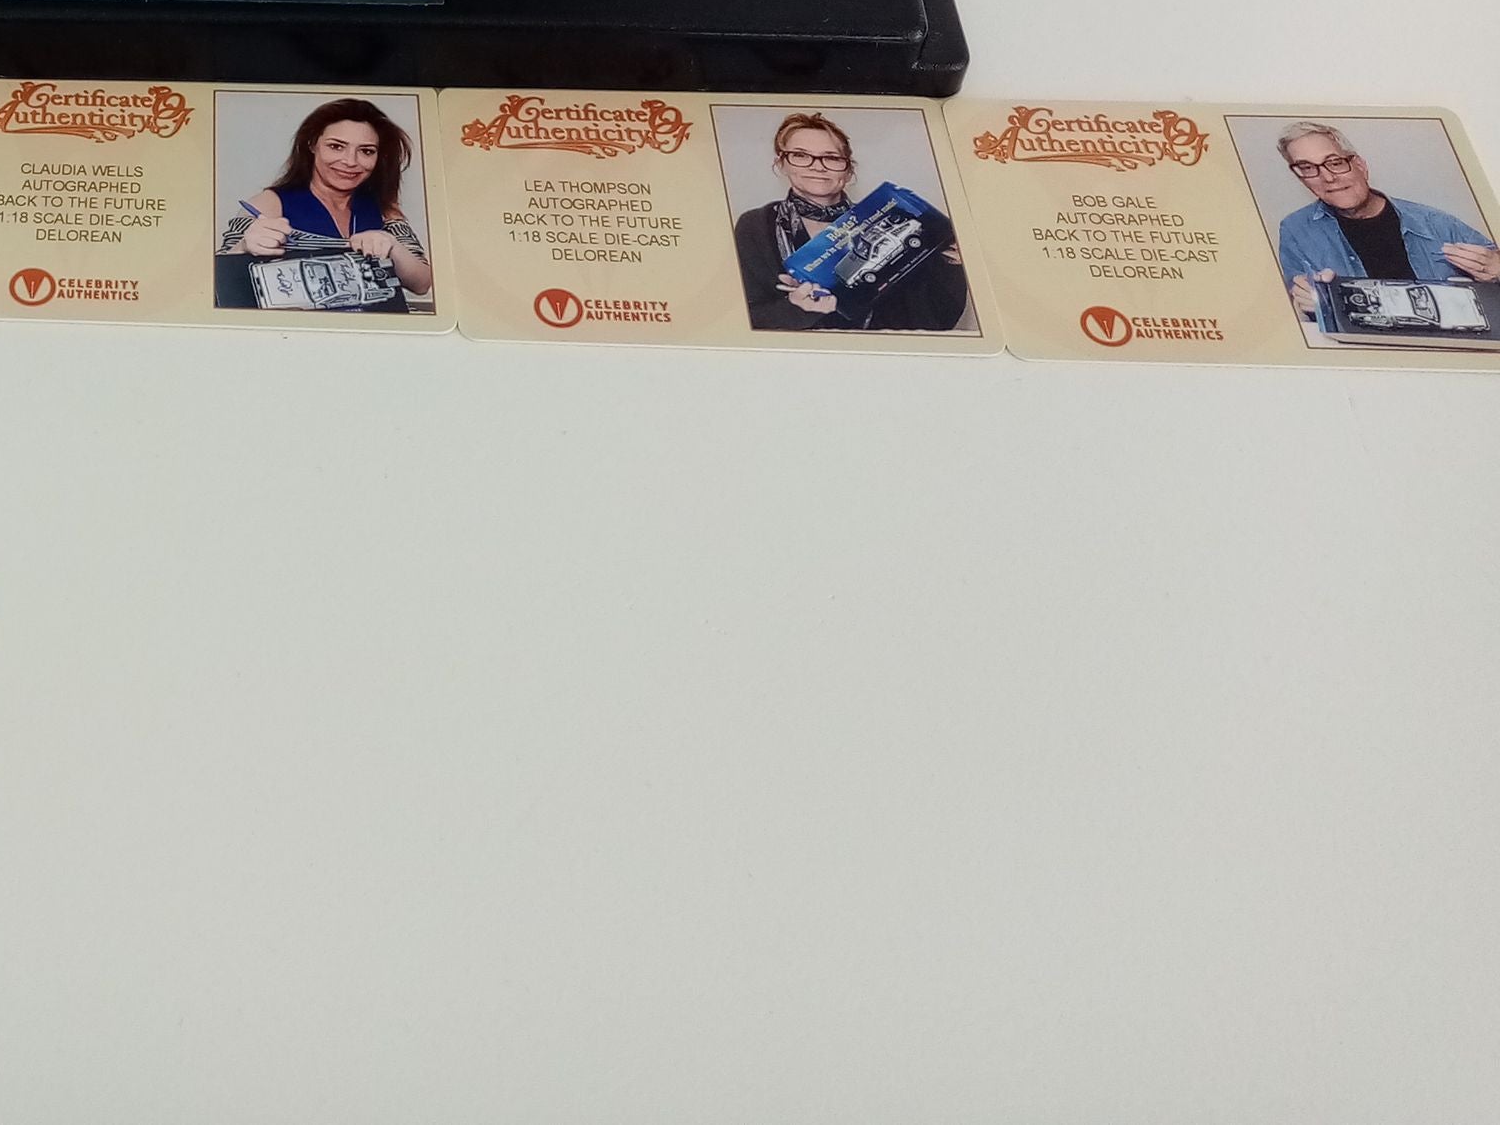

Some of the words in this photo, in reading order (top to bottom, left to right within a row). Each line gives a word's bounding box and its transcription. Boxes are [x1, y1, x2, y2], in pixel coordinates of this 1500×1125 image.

[18, 82, 153, 108] Certificate
[507, 95, 649, 122] Certificate
[1, 99, 151, 134] Authenticity
[1014, 106, 1163, 135] Certificate
[495, 114, 650, 148] Authenticity
[1000, 127, 1167, 163] Authenticity
[21, 163, 87, 176] CLAUDIA
[92, 165, 143, 177] WELLS
[22, 180, 141, 193] AUTOGRAPHED
[524, 180, 555, 192] LEA
[560, 182, 651, 194] THOMPSON
[42, 196, 63, 208] TO
[68, 197, 98, 209] THE
[104, 198, 166, 211] FUTURE
[528, 198, 653, 212] AUTOGRAPHED
[1072, 195, 1107, 207] BOB
[1112, 196, 1157, 209] GALE
[0, 212, 28, 223] 1:18
[33, 212, 84, 225] SCALE
[90, 214, 163, 227] DIE-CAST
[503, 213, 547, 225] BACK
[551, 214, 574, 226] TO
[579, 215, 611, 227] THE
[617, 216, 683, 229] FUTURE
[1056, 212, 1184, 227] AUTOGRAPHED
[36, 229, 122, 243] DELOREAN
[509, 231, 541, 243] 1:18
[546, 232, 599, 244] SCALE
[605, 233, 681, 247] DIE-CAST
[1033, 228, 1079, 241] BACK
[1083, 230, 1106, 242] TO
[1111, 231, 1146, 243] THE
[1150, 232, 1219, 245] FUTURE
[552, 248, 642, 262] DELOREAN
[1080, 248, 1136, 261] SCALE
[1141, 249, 1219, 263] DIE-CAST
[1090, 265, 1184, 279] DELOREAN
[59, 278, 139, 289] CELEBRITY
[57, 289, 139, 301] AUTHENTICS
[584, 300, 668, 311] CELEBRITY
[586, 311, 671, 322] AUTHENTICS
[1132, 317, 1218, 329] CELEBRITY
[1136, 330, 1224, 340] AUTHENTICS
